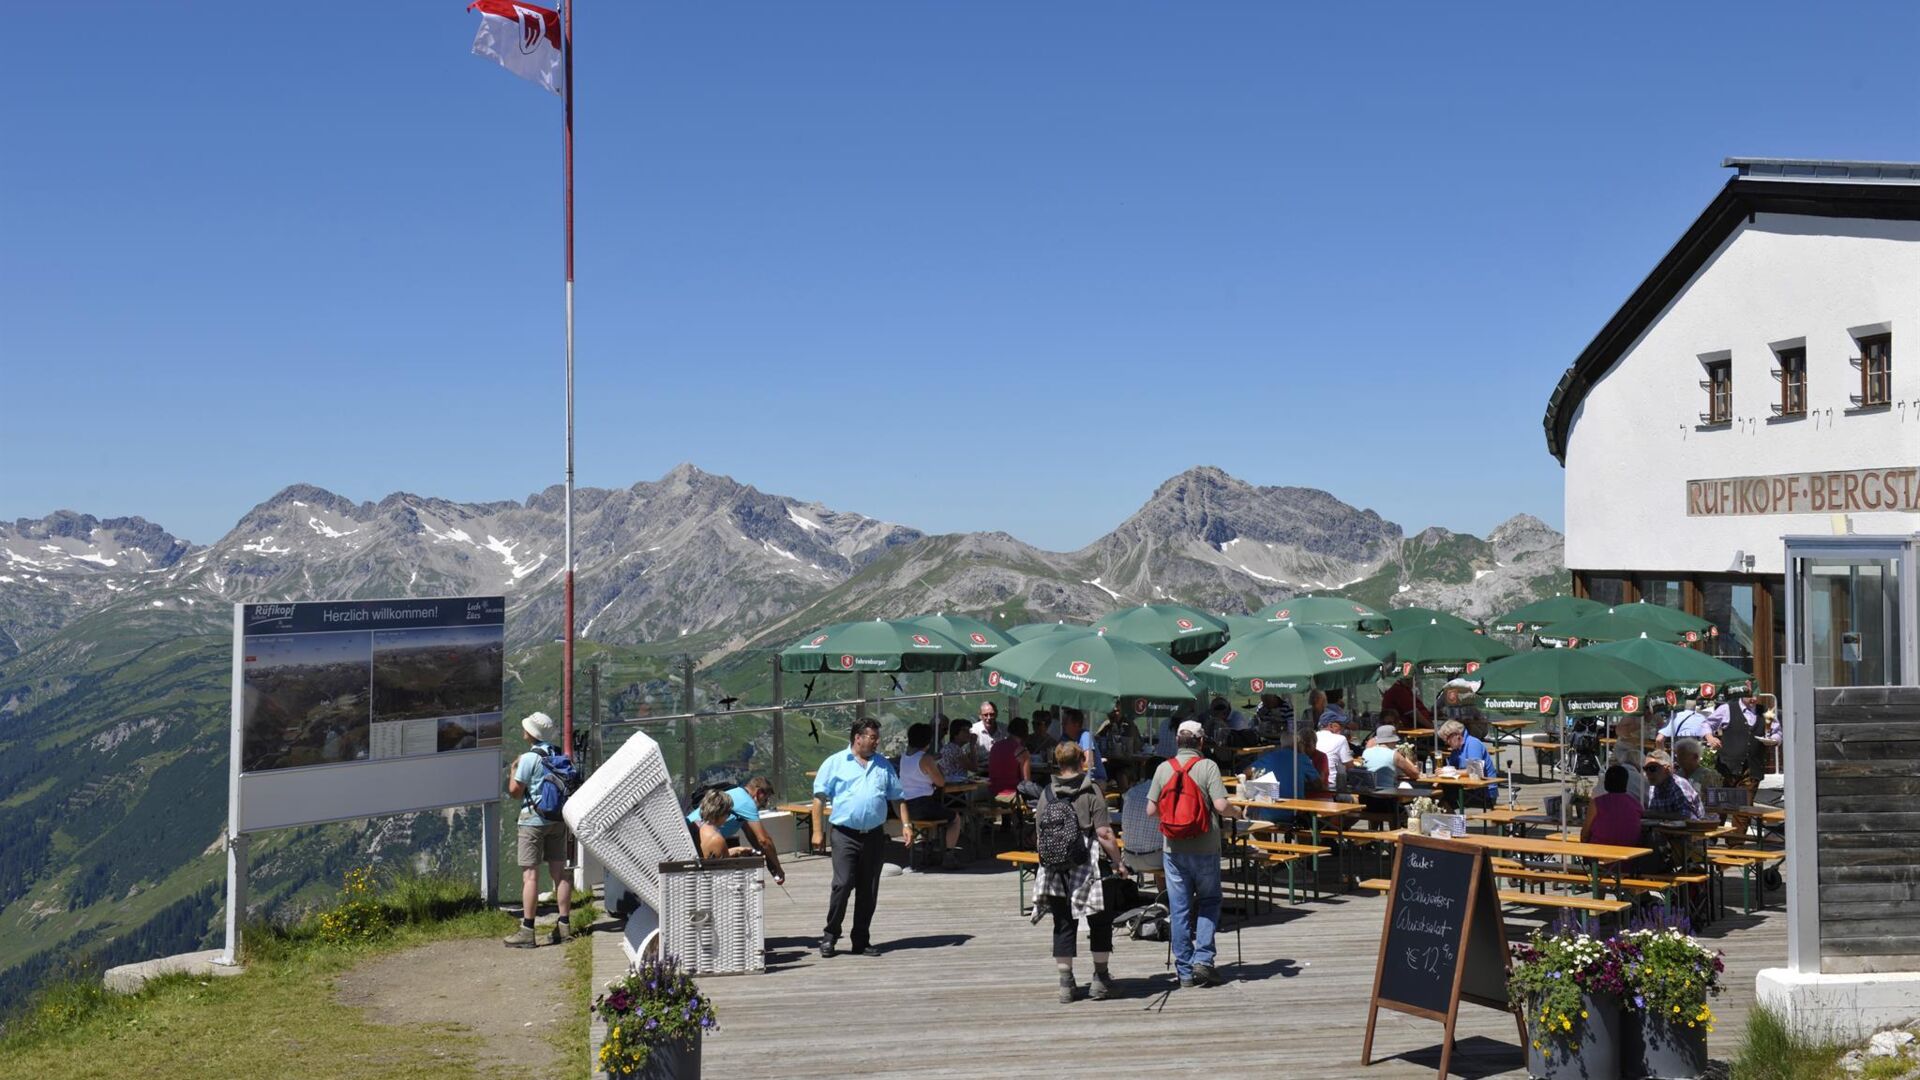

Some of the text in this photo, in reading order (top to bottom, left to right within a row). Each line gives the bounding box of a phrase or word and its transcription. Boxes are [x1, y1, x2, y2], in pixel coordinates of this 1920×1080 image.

[255, 603, 297, 618] Rüfikopf
[323, 606, 439, 622] Herzlich willkommen!
[1485, 697, 1538, 710] fohrenburger
